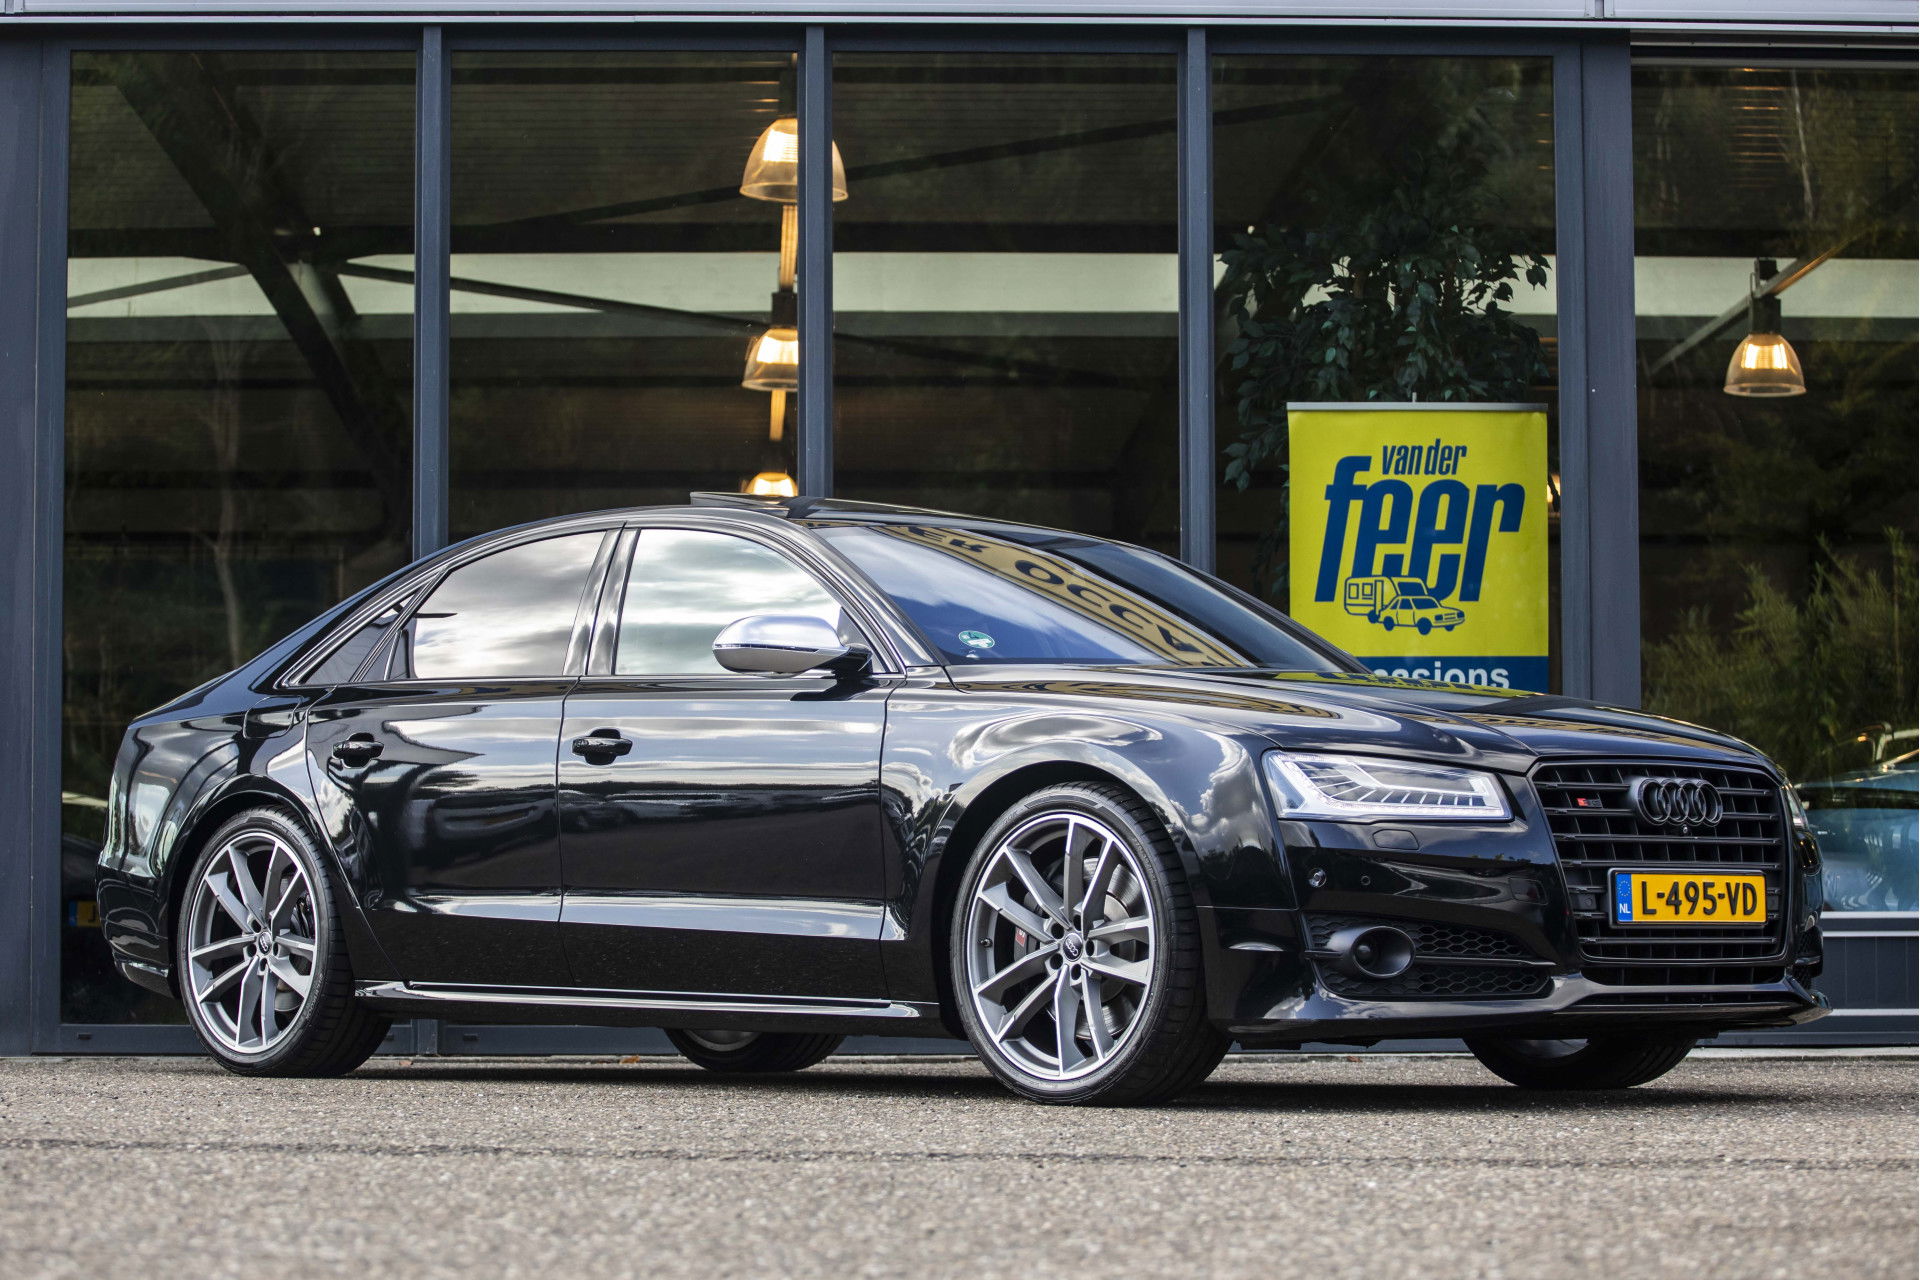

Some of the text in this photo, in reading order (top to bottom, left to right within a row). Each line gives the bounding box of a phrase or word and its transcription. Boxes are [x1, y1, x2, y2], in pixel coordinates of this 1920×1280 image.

[1382, 438, 1467, 475] van der
[1314, 455, 1525, 602] feer
[1619, 903, 1631, 914] NL
[1641, 880, 1758, 916] L-495-VD
